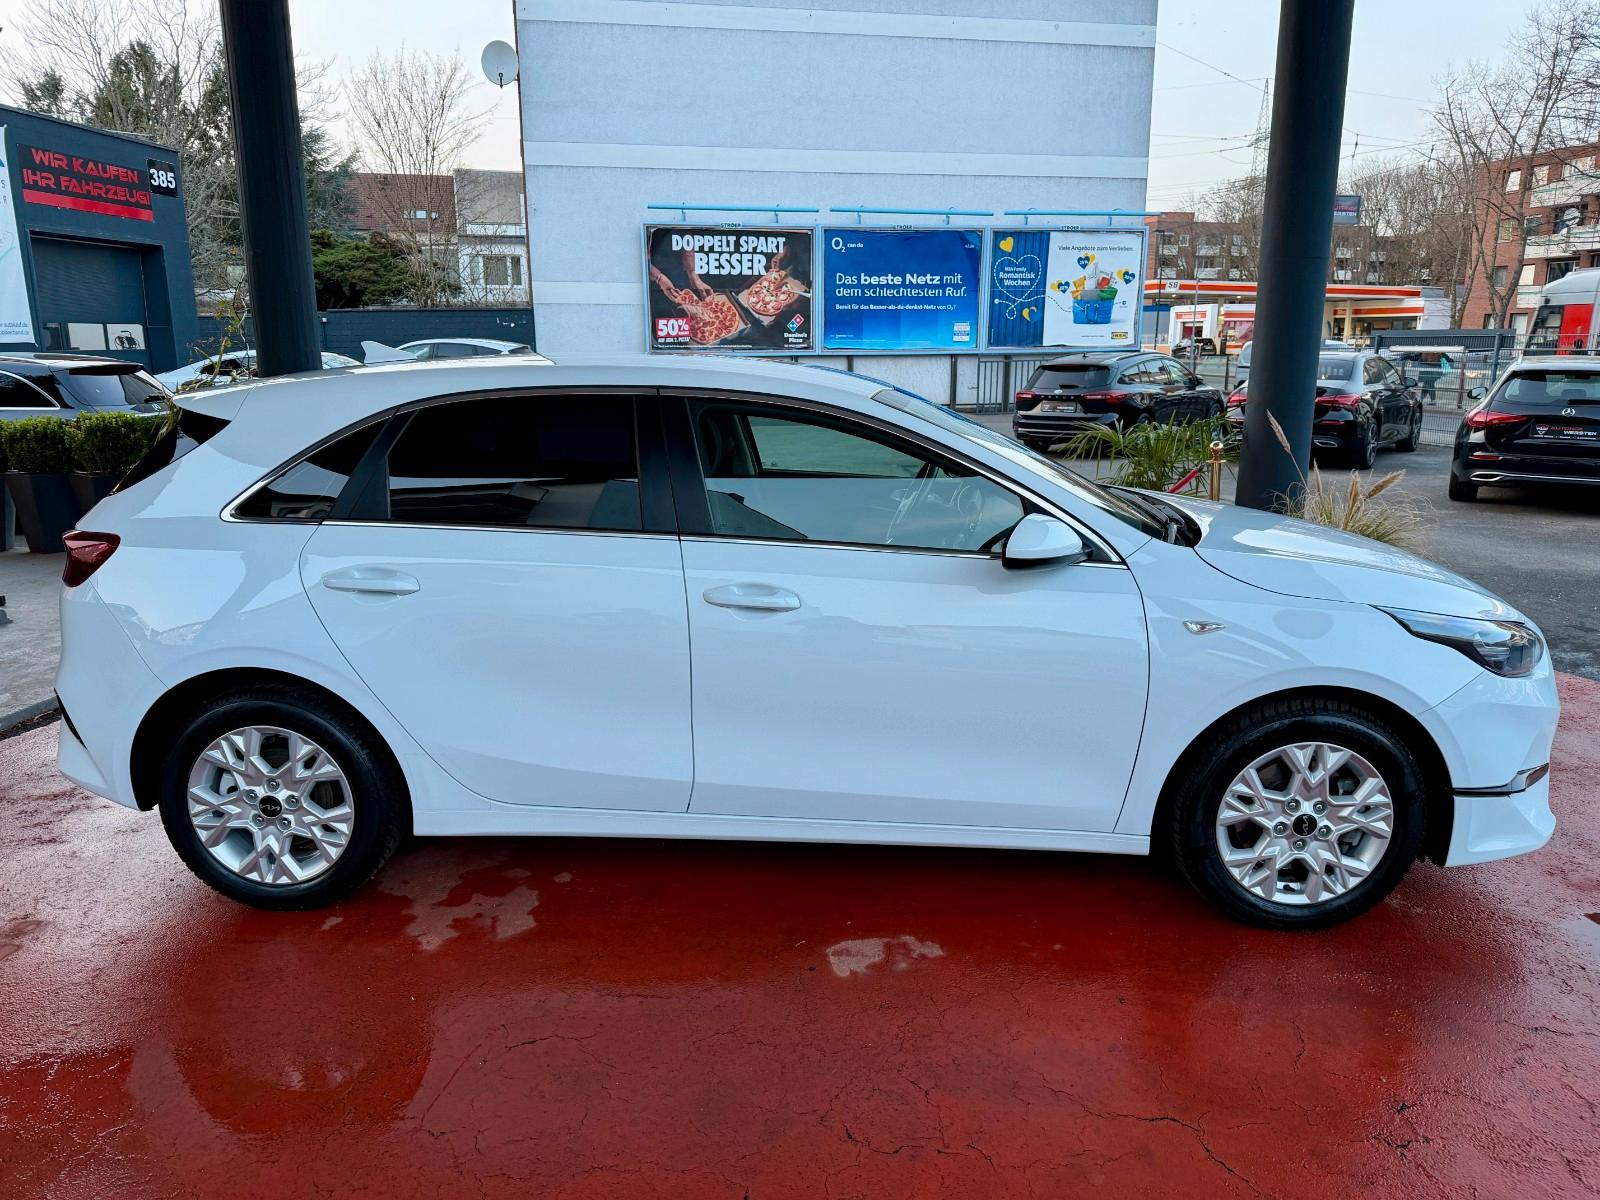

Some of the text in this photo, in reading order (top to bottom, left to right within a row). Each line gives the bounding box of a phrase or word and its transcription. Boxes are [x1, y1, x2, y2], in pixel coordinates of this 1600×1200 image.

[31, 147, 139, 184] WIR KAUFEN
[22, 168, 56, 189] IHR
[149, 168, 176, 189] 385
[671, 234, 786, 253] DOPPELT SPART
[694, 252, 767, 276] BESSER
[836, 272, 963, 285] Das beste Netz mit
[835, 286, 967, 297] dem schlechtesten Ruf.
[657, 319, 690, 337] 50%
